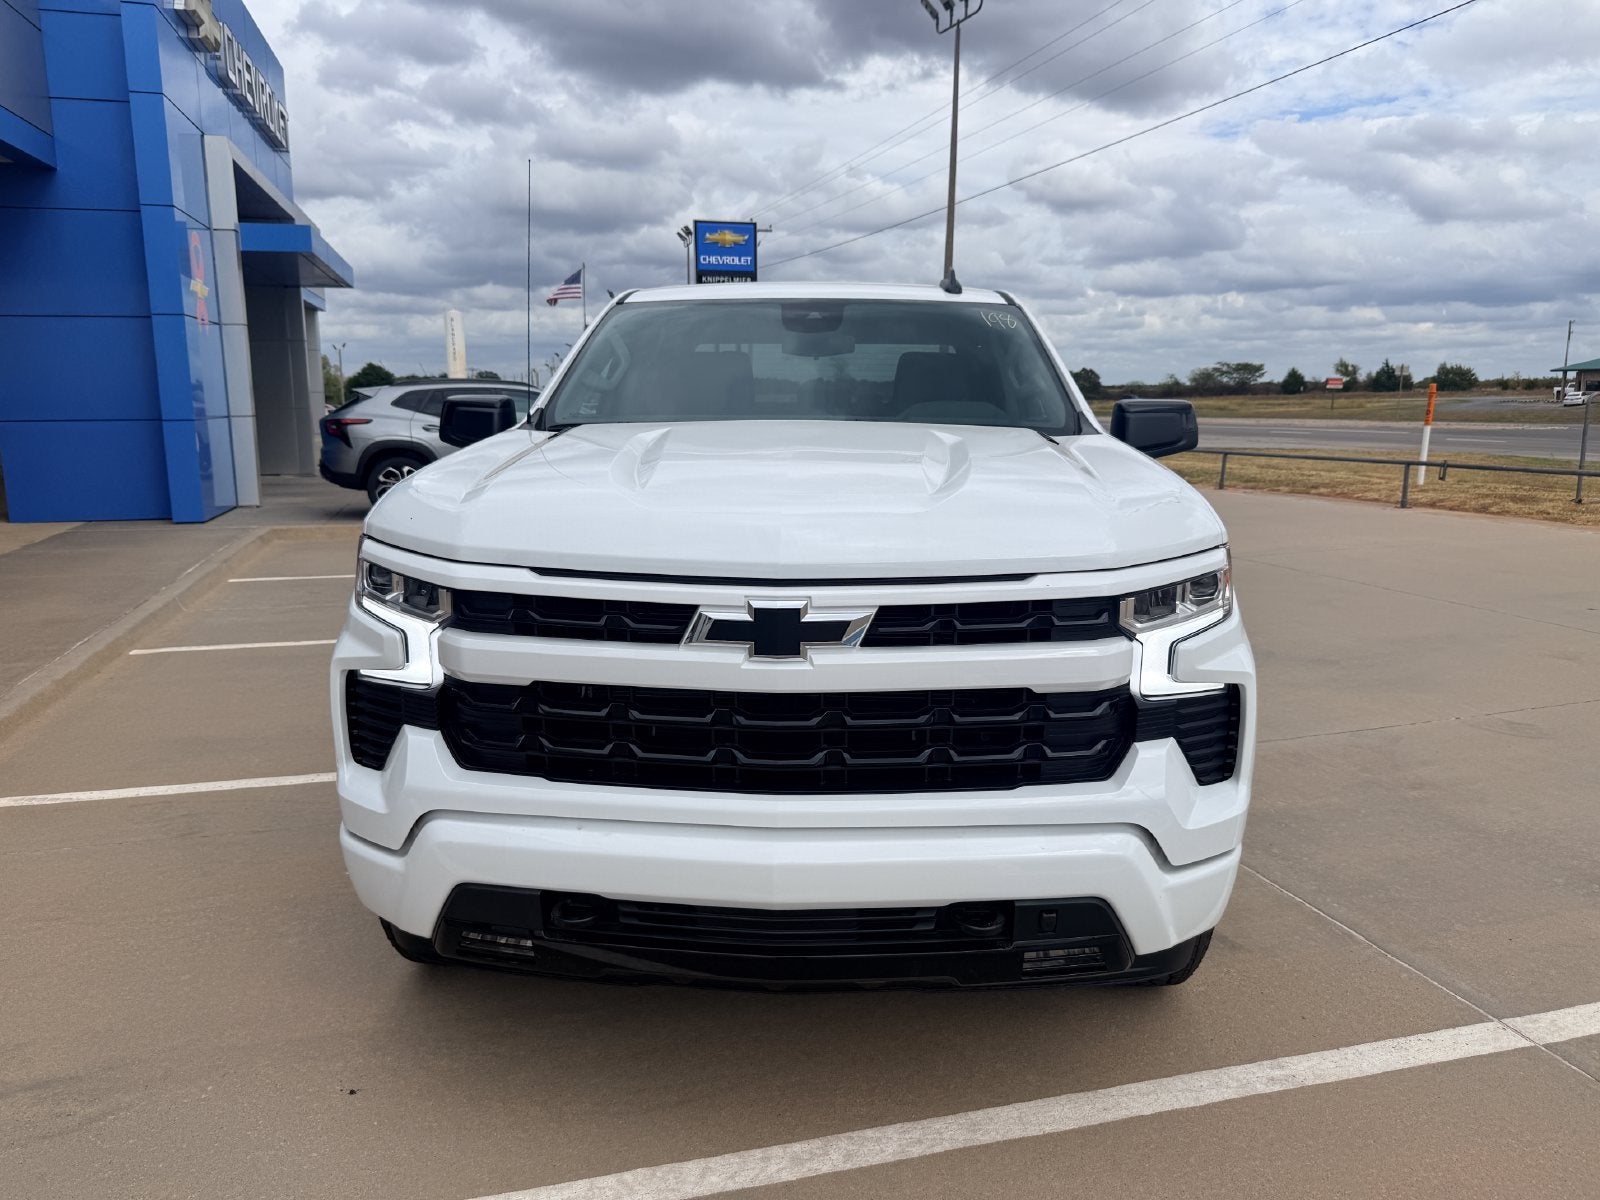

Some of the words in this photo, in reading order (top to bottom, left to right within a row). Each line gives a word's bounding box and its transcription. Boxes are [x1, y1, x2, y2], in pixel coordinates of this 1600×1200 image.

[220, 22, 289, 152] CHEVROLET
[700, 255, 752, 265] CHEVROLET
[980, 311, 1017, 329] 198
